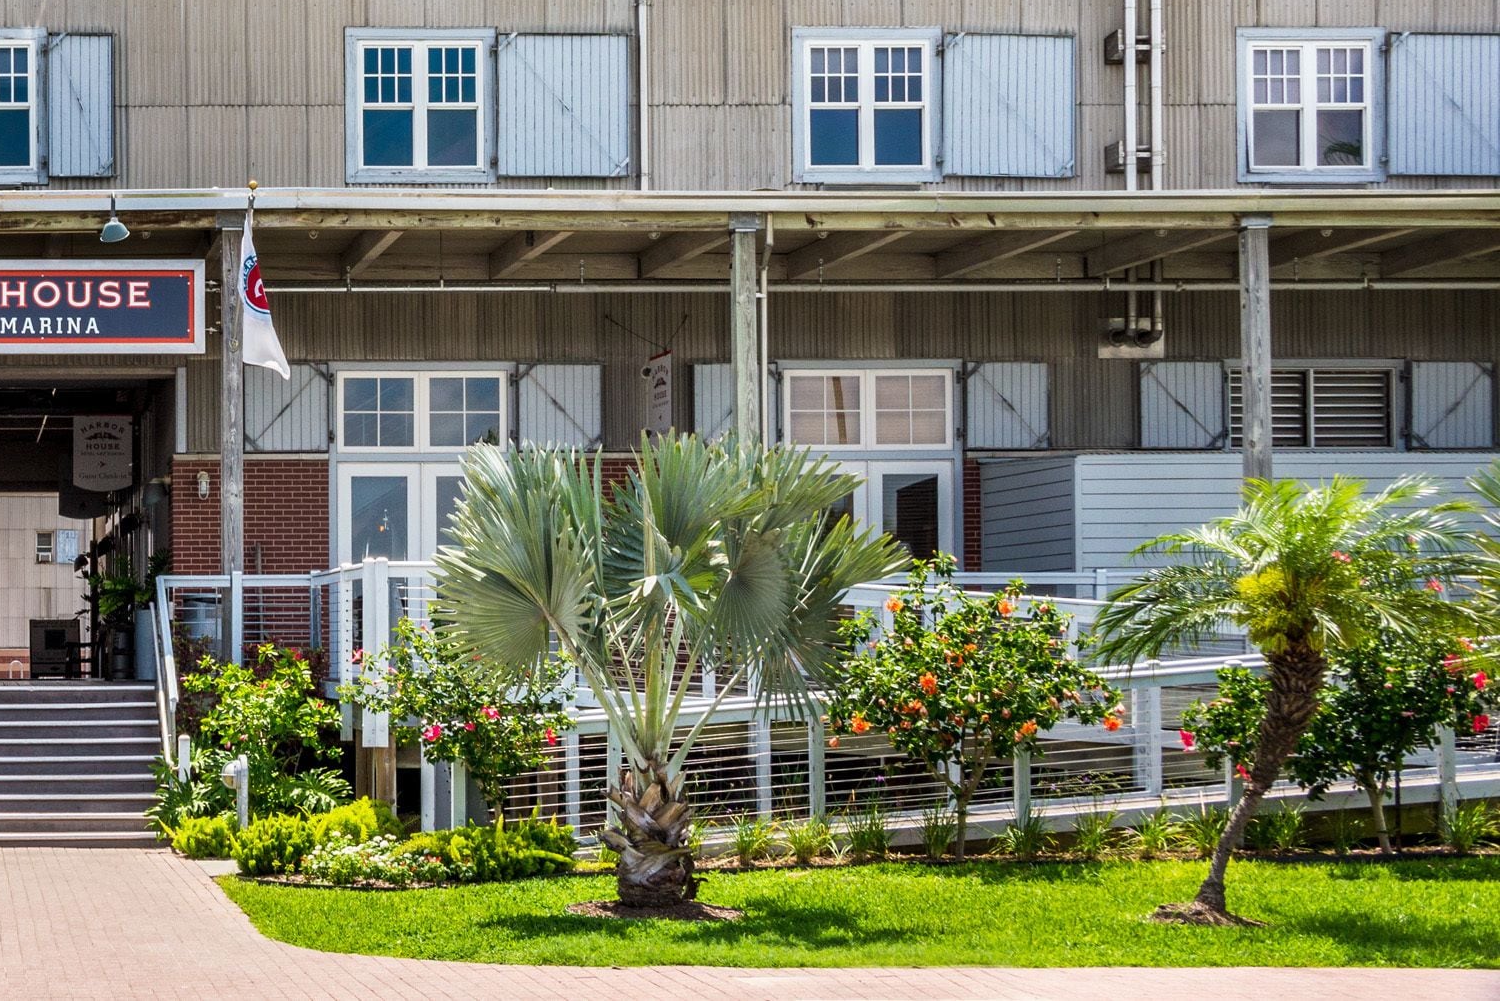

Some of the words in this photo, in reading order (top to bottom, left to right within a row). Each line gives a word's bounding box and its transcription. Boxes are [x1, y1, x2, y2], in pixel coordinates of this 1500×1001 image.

[0, 280, 151, 309] HOUSE
[0, 316, 100, 335] MARINA
[80, 422, 125, 434] HARBOR
